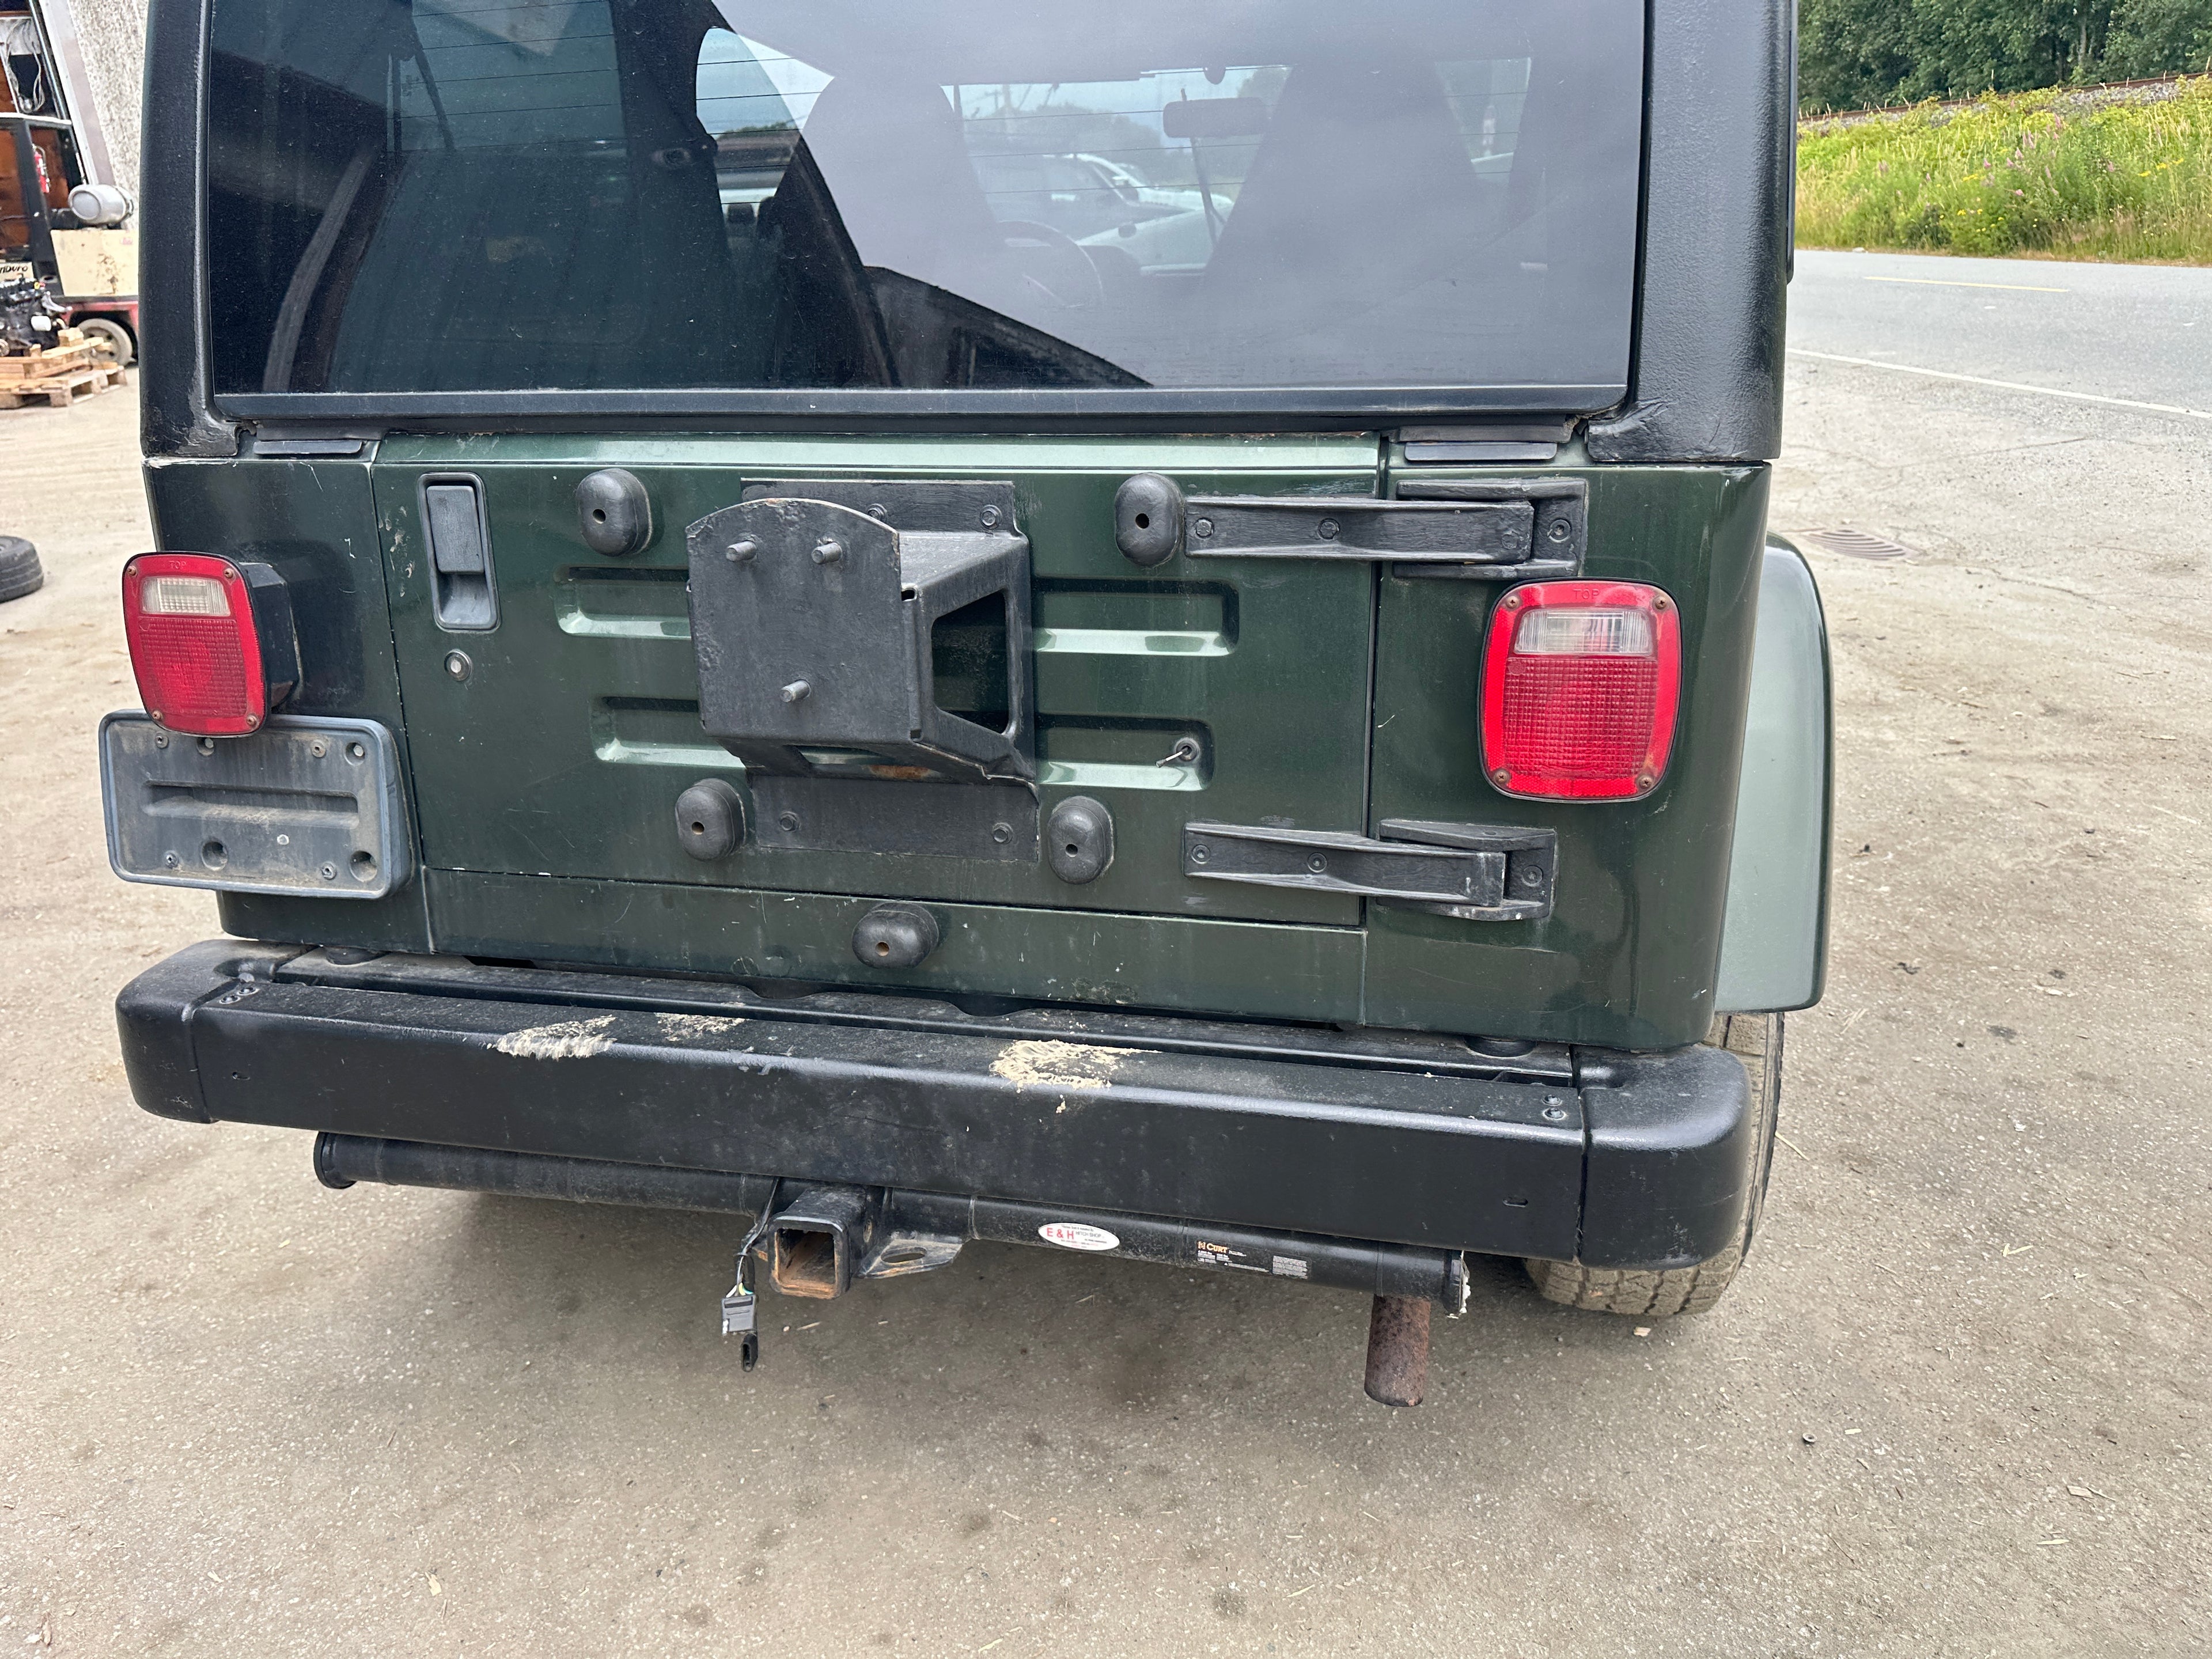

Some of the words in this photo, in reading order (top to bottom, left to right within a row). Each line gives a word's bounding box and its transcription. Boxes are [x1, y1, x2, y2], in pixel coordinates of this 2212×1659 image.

[169, 560, 187, 569] TOP
[1573, 588, 1600, 600] TOP
[1047, 1228, 1053, 1237] E
[1056, 1229, 1063, 1238] &
[1067, 1230, 1074, 1239] H
[1207, 1243, 1228, 1253] CURT
